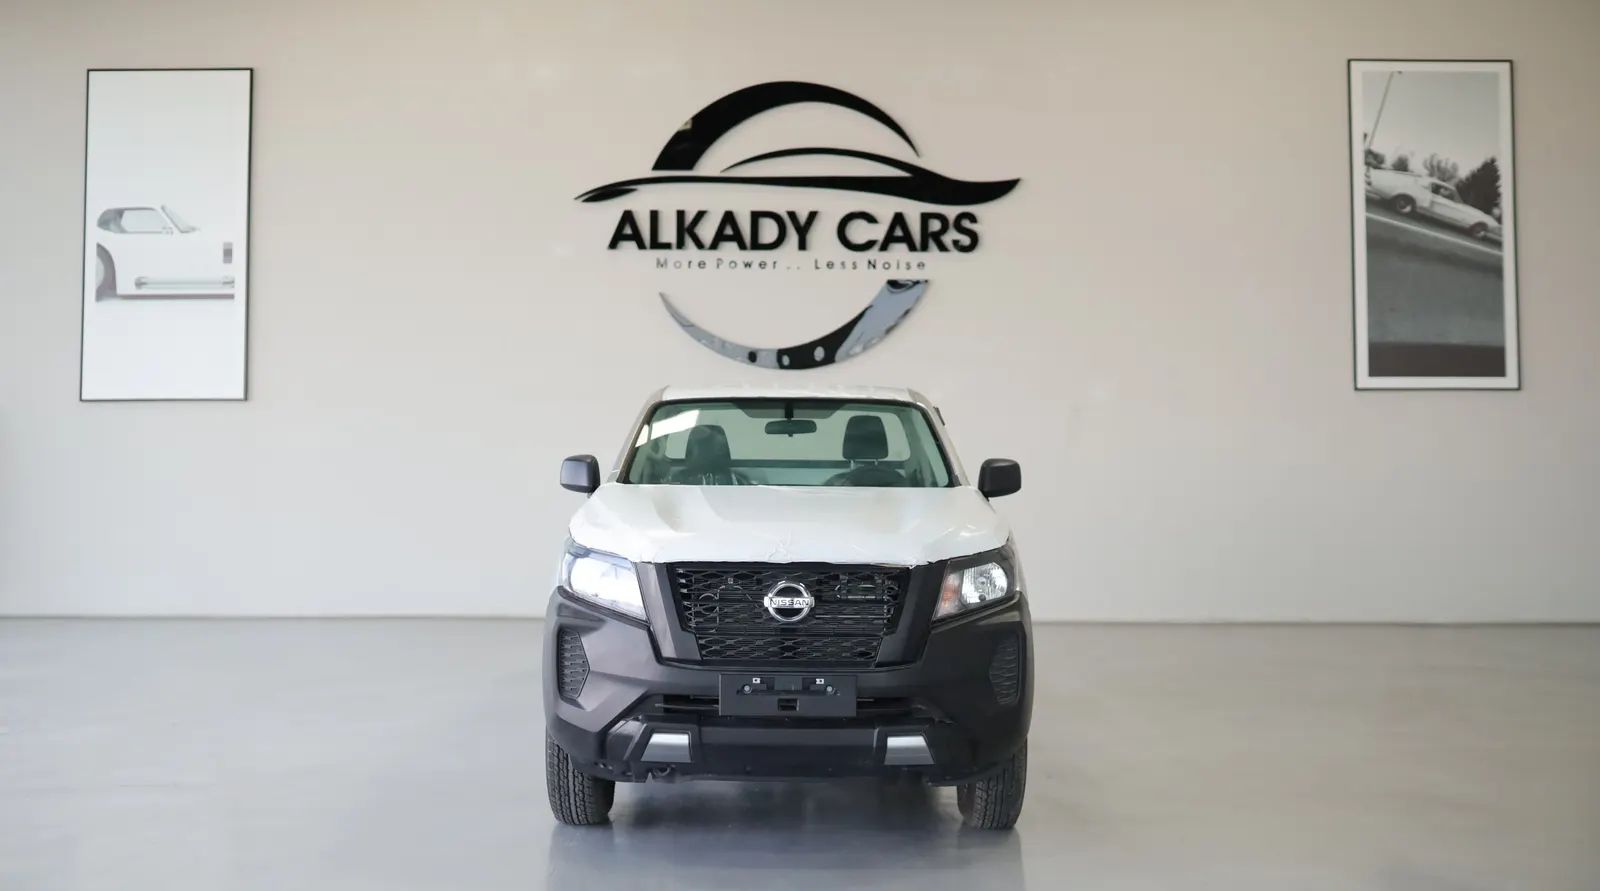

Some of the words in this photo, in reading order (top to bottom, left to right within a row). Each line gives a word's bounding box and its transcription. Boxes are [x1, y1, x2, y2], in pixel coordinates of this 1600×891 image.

[607, 209, 819, 251] ALKADY
[836, 210, 980, 253] CARS
[655, 257, 708, 270] More
[813, 258, 859, 271] Less
[866, 258, 926, 271] Noise
[769, 598, 810, 606] NISSAN
